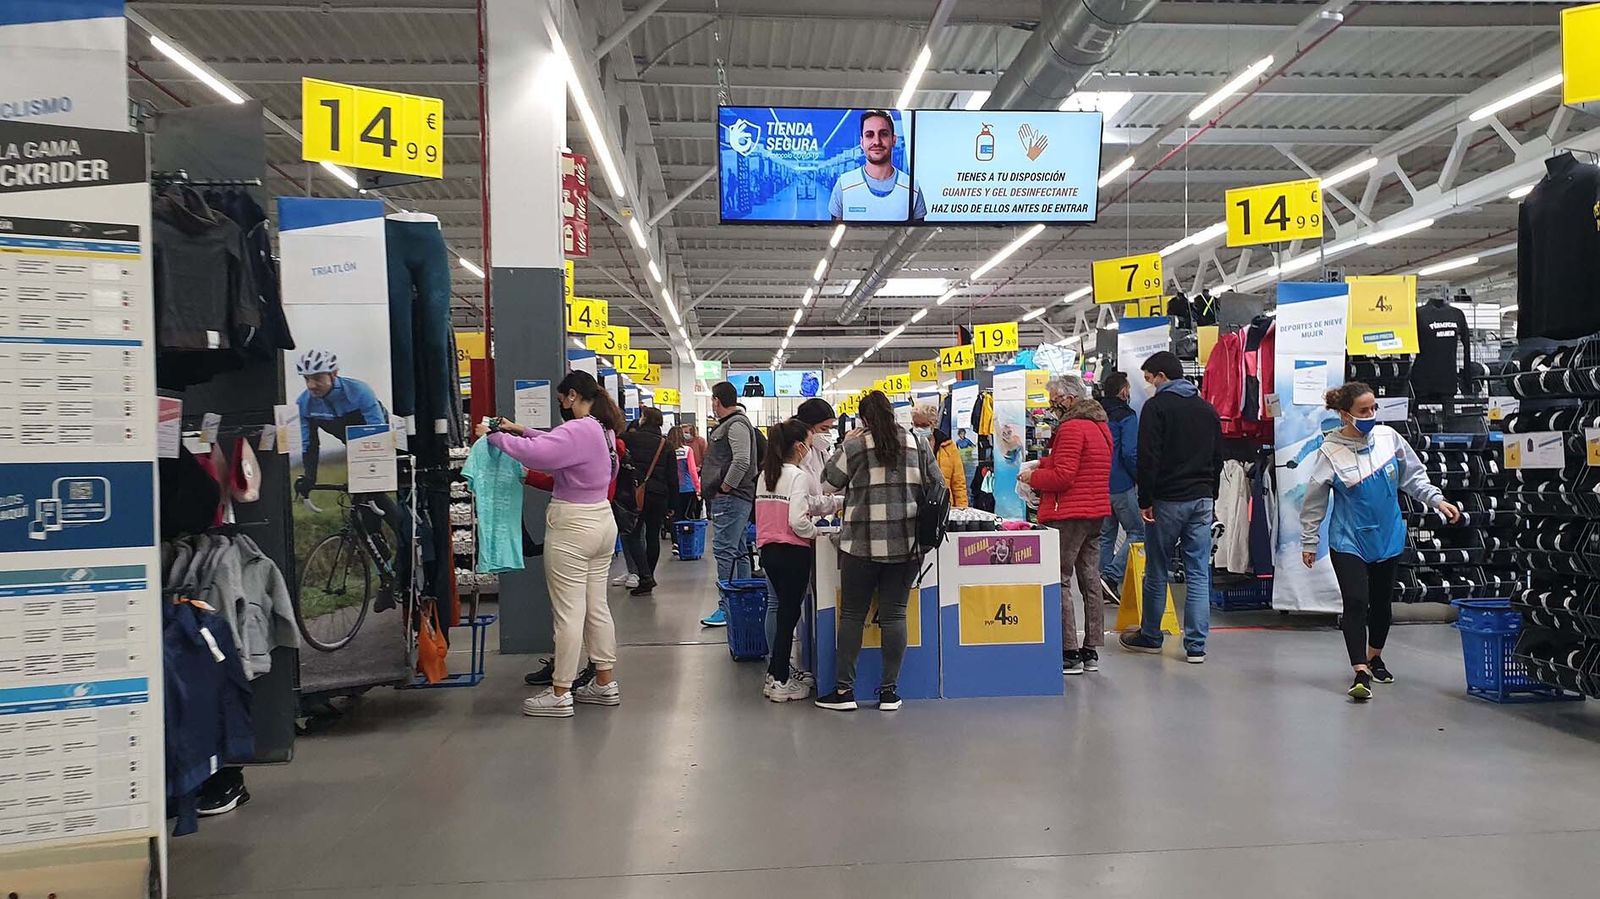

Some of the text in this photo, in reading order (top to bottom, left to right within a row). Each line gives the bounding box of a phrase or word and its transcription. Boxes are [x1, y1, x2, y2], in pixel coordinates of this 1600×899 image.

[320, 98, 437, 158] 14 €
[766, 122, 814, 137] TIENDA
[23, 140, 82, 158] GAMA
[766, 138, 819, 151] SEGURA
[957, 170, 1066, 182] TIENES A TU DISPOSICIÓN
[942, 187, 1079, 197] GUANTES Y GEL DESINFECTANTE
[931, 204, 1089, 213] HAZ USO DE ELLOS ANTES DE ENTRAR
[1236, 195, 1291, 236] 14
[1120, 263, 1139, 293] 7
[1375, 295, 1386, 312] 4
[1280, 318, 1343, 332] DEPORTES DE NIEVE
[604, 331, 616, 350] 3
[979, 329, 1004, 348] 19
[1301, 329, 1324, 338] MUJER
[942, 351, 963, 367] 44
[920, 364, 928, 378] 8
[889, 378, 903, 390] 18
[994, 603, 1008, 625] 4
